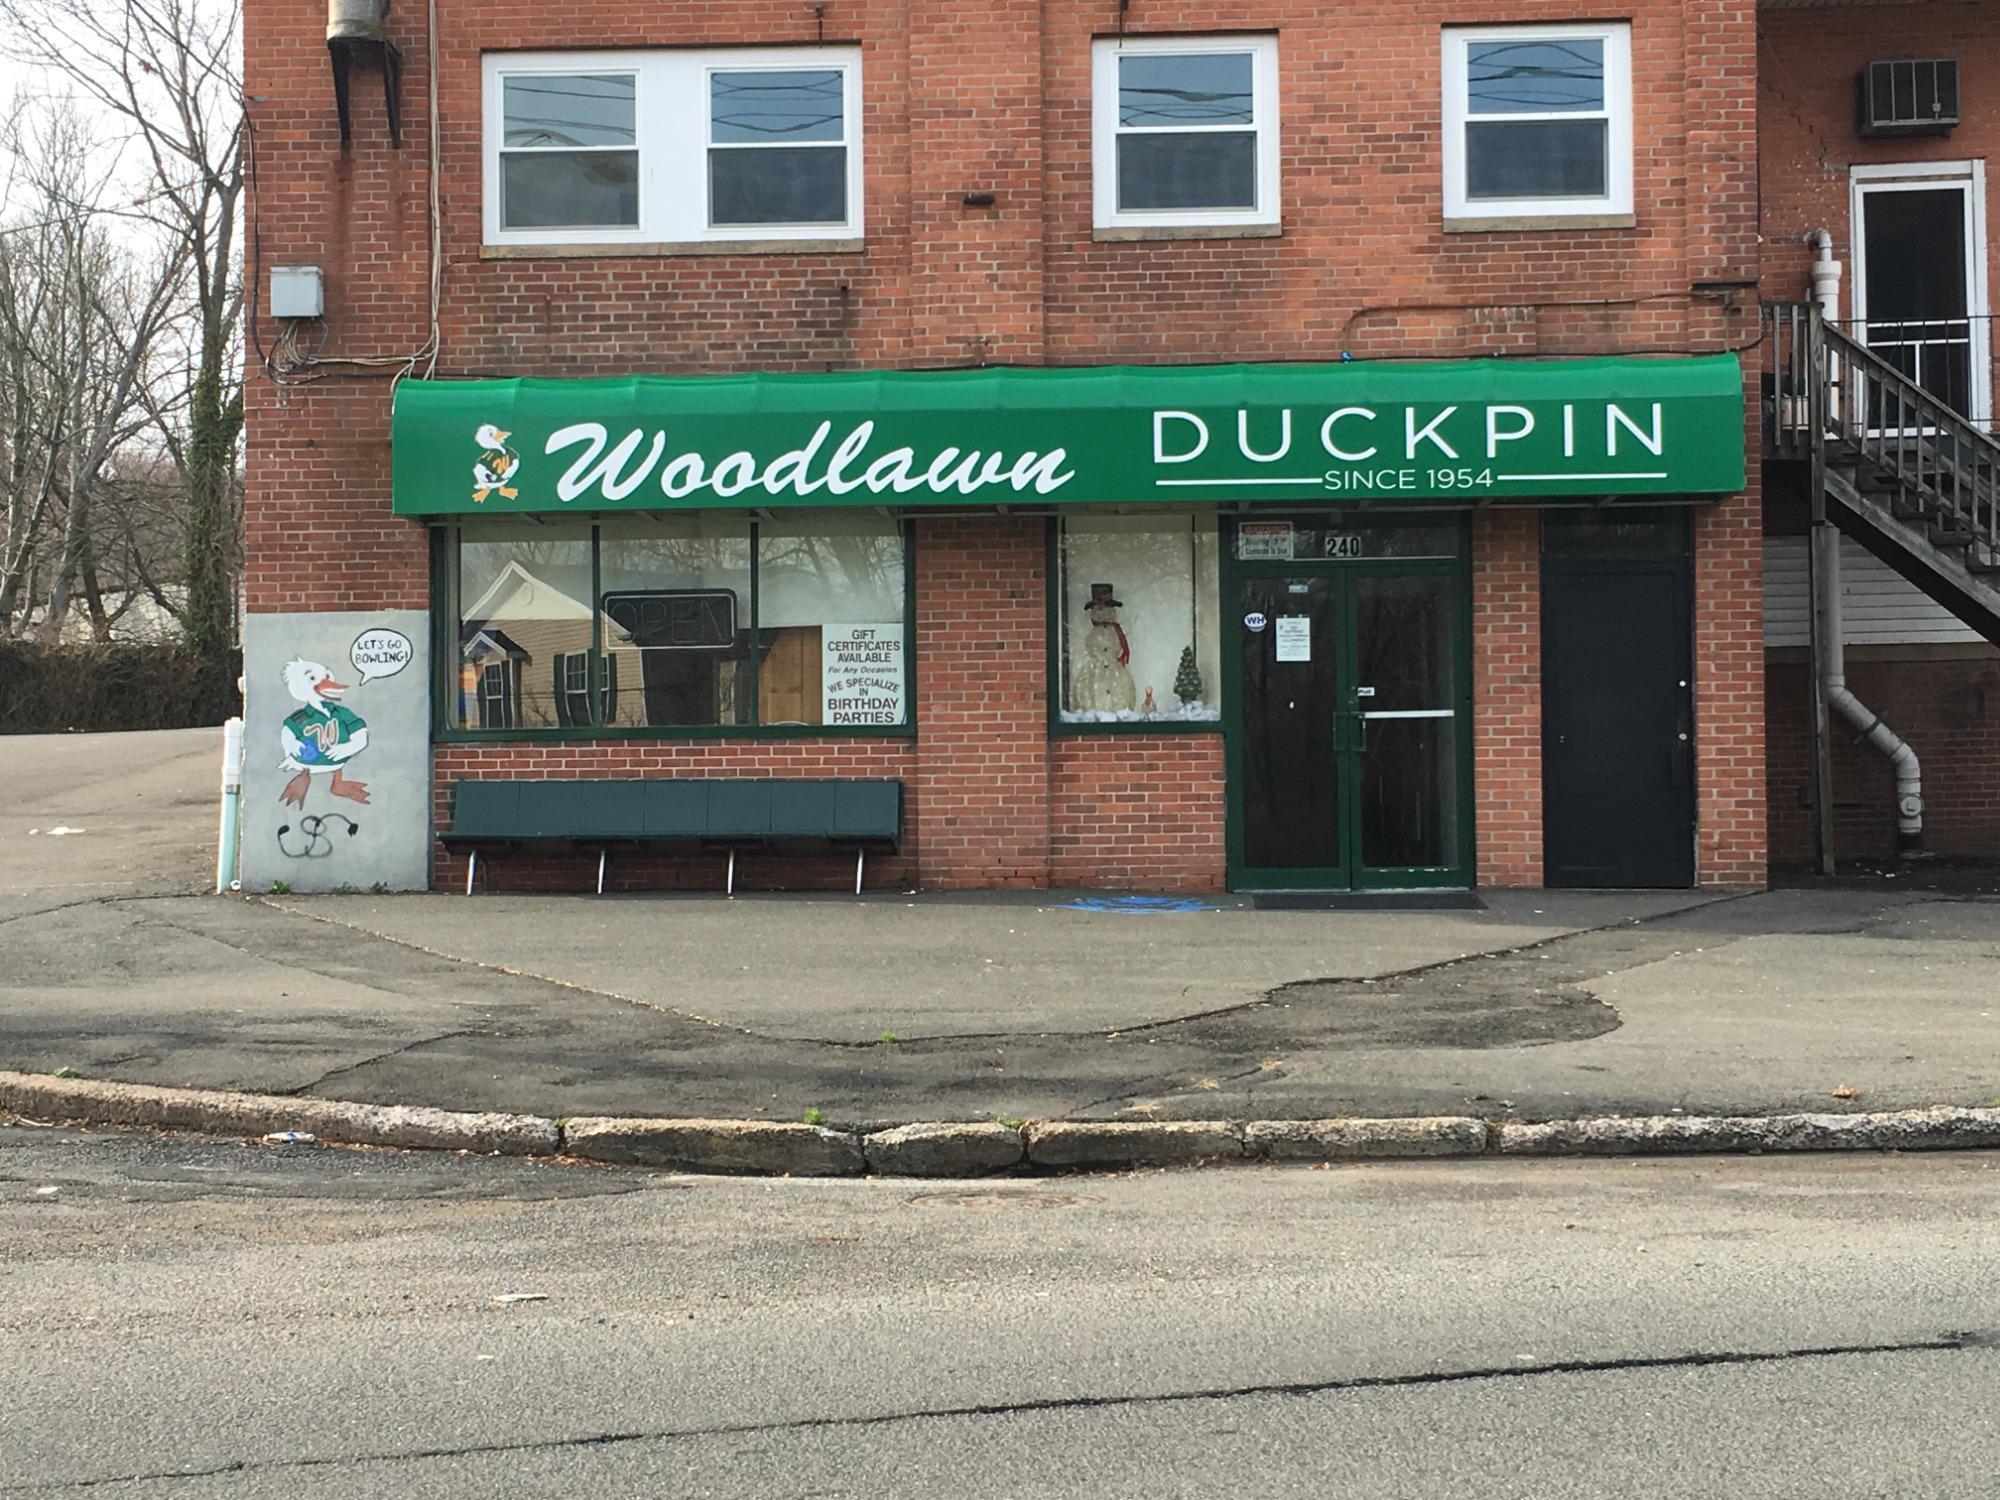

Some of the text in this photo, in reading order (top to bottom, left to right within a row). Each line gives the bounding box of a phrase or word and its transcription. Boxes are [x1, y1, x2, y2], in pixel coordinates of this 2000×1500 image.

[1154, 403, 1663, 463] DUCKPIN
[545, 420, 1075, 501] Woodlawn
[1324, 468, 1494, 490] SINCE 1954
[1326, 537, 1360, 556] 240
[1247, 616, 1265, 625] WH
[852, 629, 876, 640] GIFT
[387, 639, 402, 649] GO
[827, 641, 900, 652] CERTIFICATES
[355, 650, 409, 664] BOWLING!
[837, 652, 891, 663] AVAILABLE
[843, 666, 858, 674] Any
[827, 677, 900, 693] WE SPECIALIZE
[859, 688, 868, 696] IN
[828, 698, 899, 710] BIRTHDAY
[833, 712, 894, 723] PARTIES
